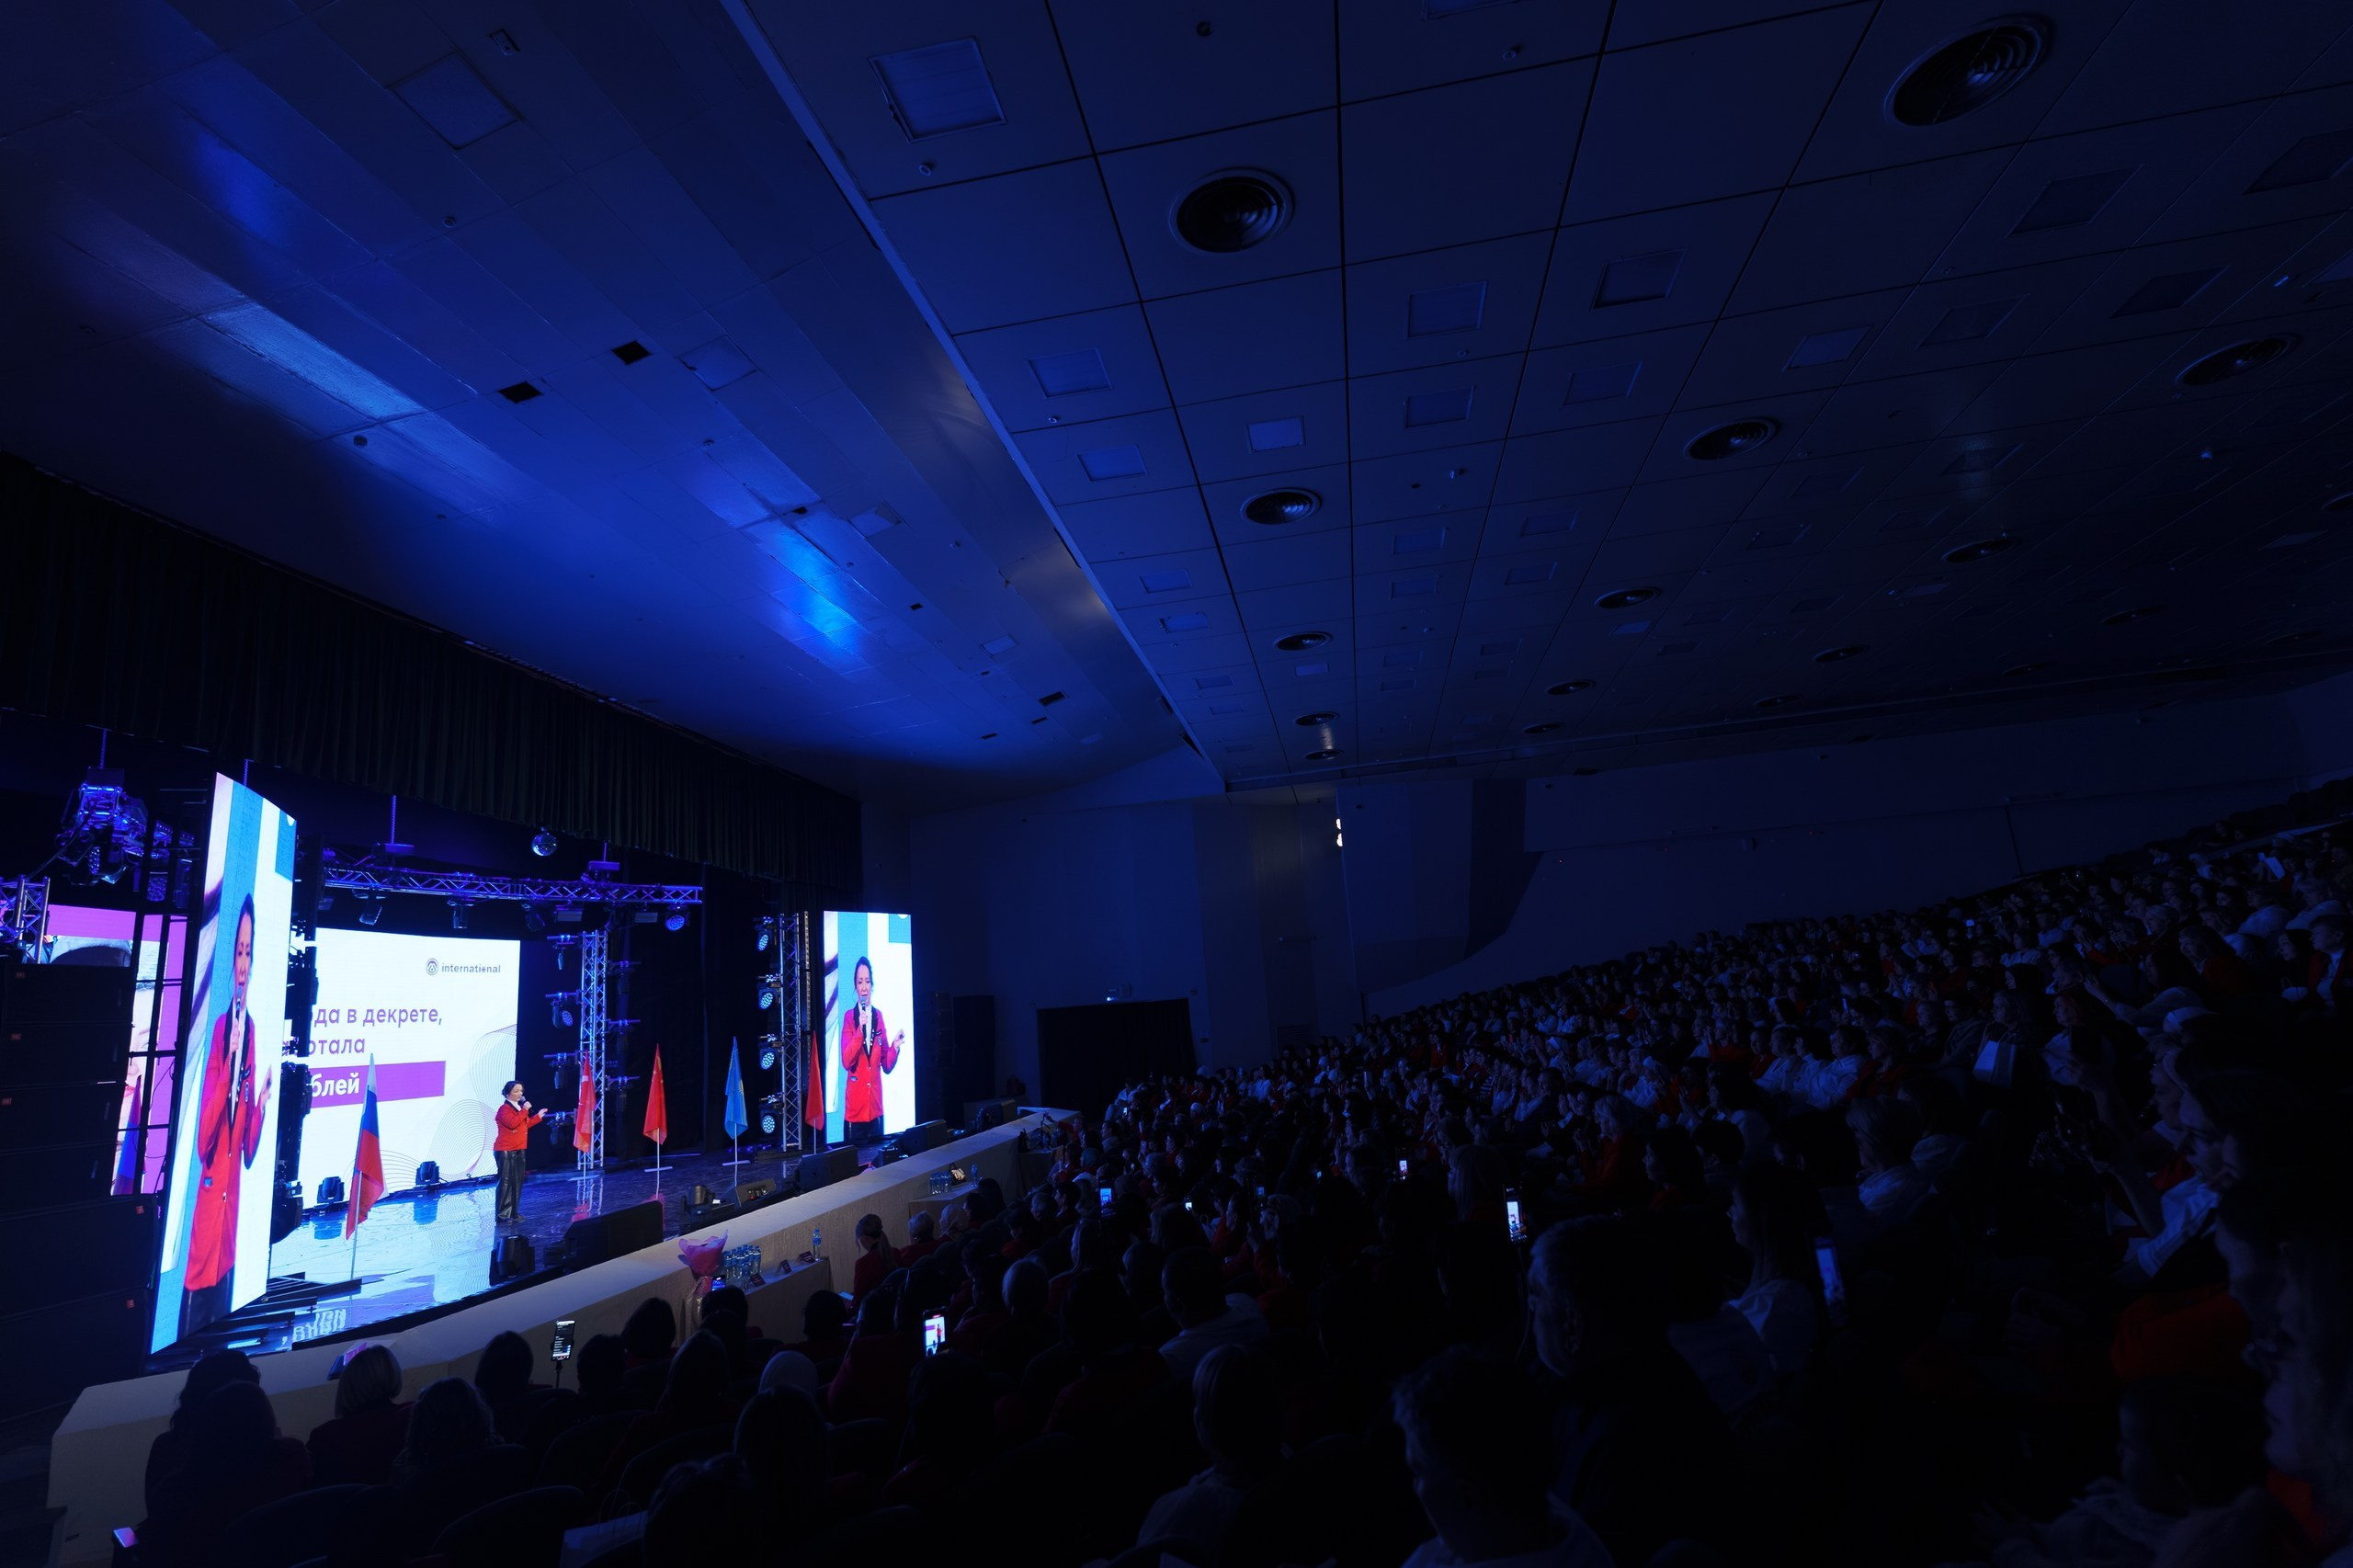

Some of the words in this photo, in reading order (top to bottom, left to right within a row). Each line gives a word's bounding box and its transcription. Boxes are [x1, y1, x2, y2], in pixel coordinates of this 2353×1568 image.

[441, 962, 501, 973] international
[313, 1008, 340, 1028] да
[347, 1008, 358, 1024] в
[362, 1007, 443, 1028] декрете,
[308, 1038, 366, 1056] отала
[311, 1072, 359, 1098] блей
